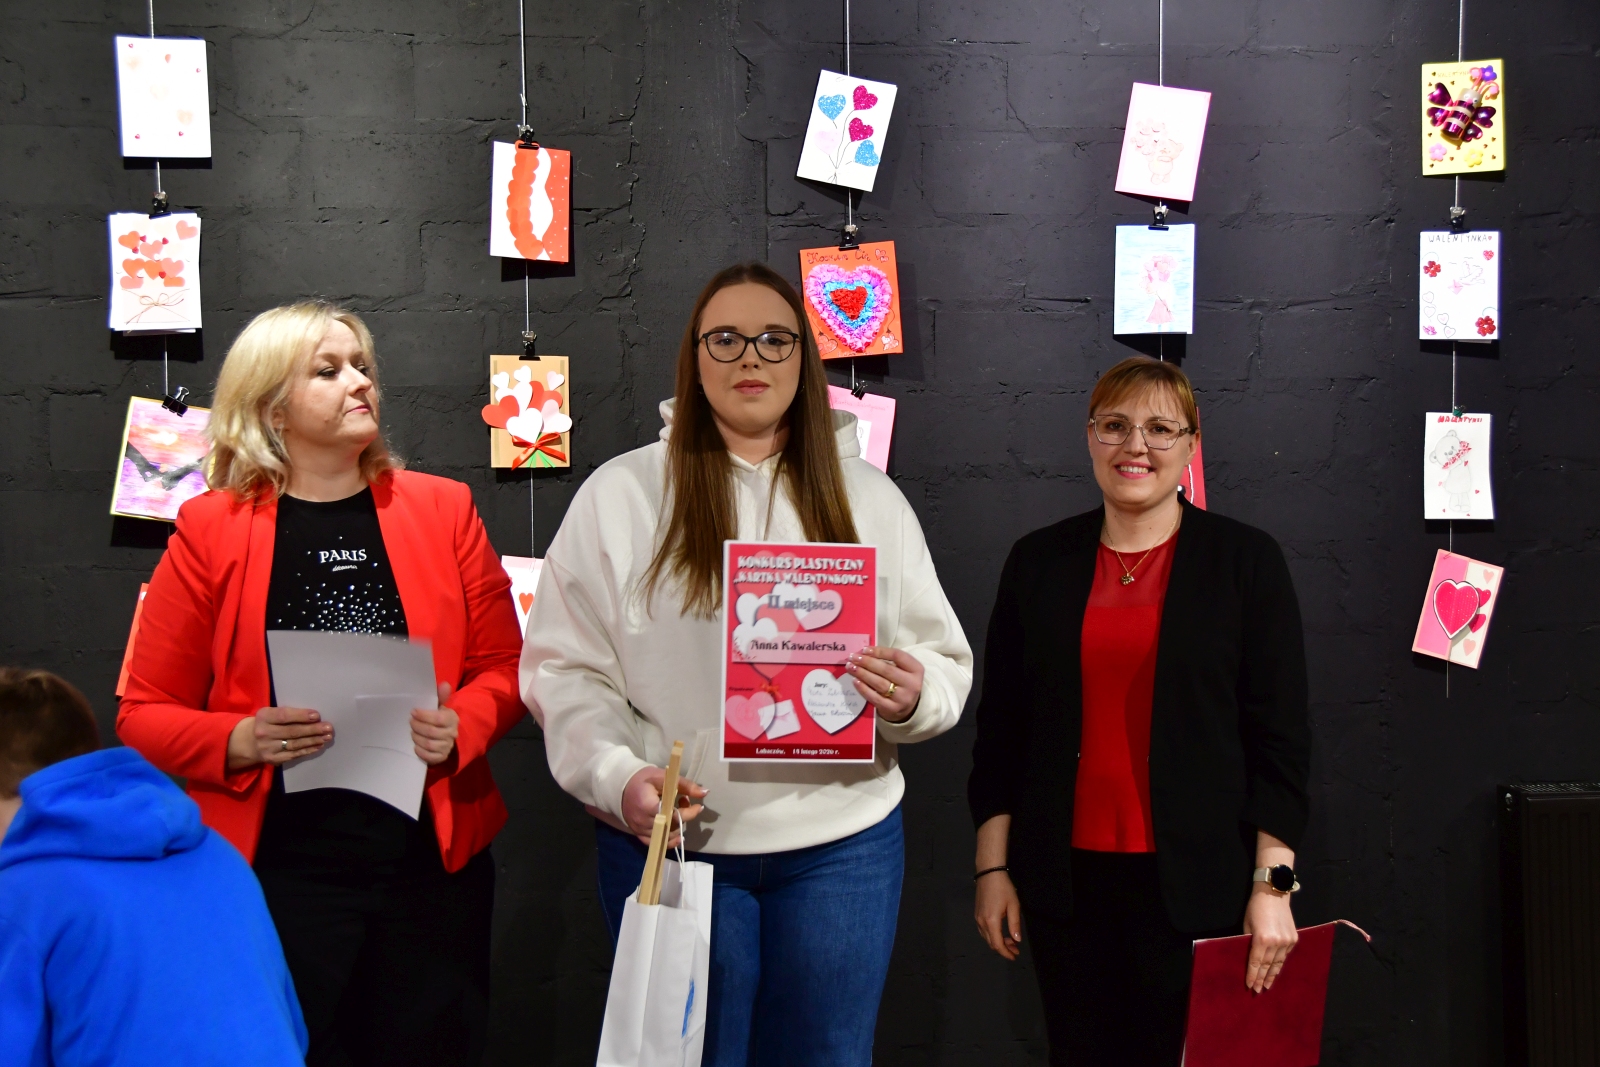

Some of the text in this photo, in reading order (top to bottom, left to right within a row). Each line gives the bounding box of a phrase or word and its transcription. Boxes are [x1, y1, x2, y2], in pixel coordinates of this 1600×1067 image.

[1428, 234, 1487, 243] WALENTYNKA
[319, 548, 367, 563] PARIS
[737, 556, 865, 571] KONKURS PLASTYCZNY
[767, 595, 835, 612] II miejsce
[751, 640, 846, 651] Anna Kawalerska
